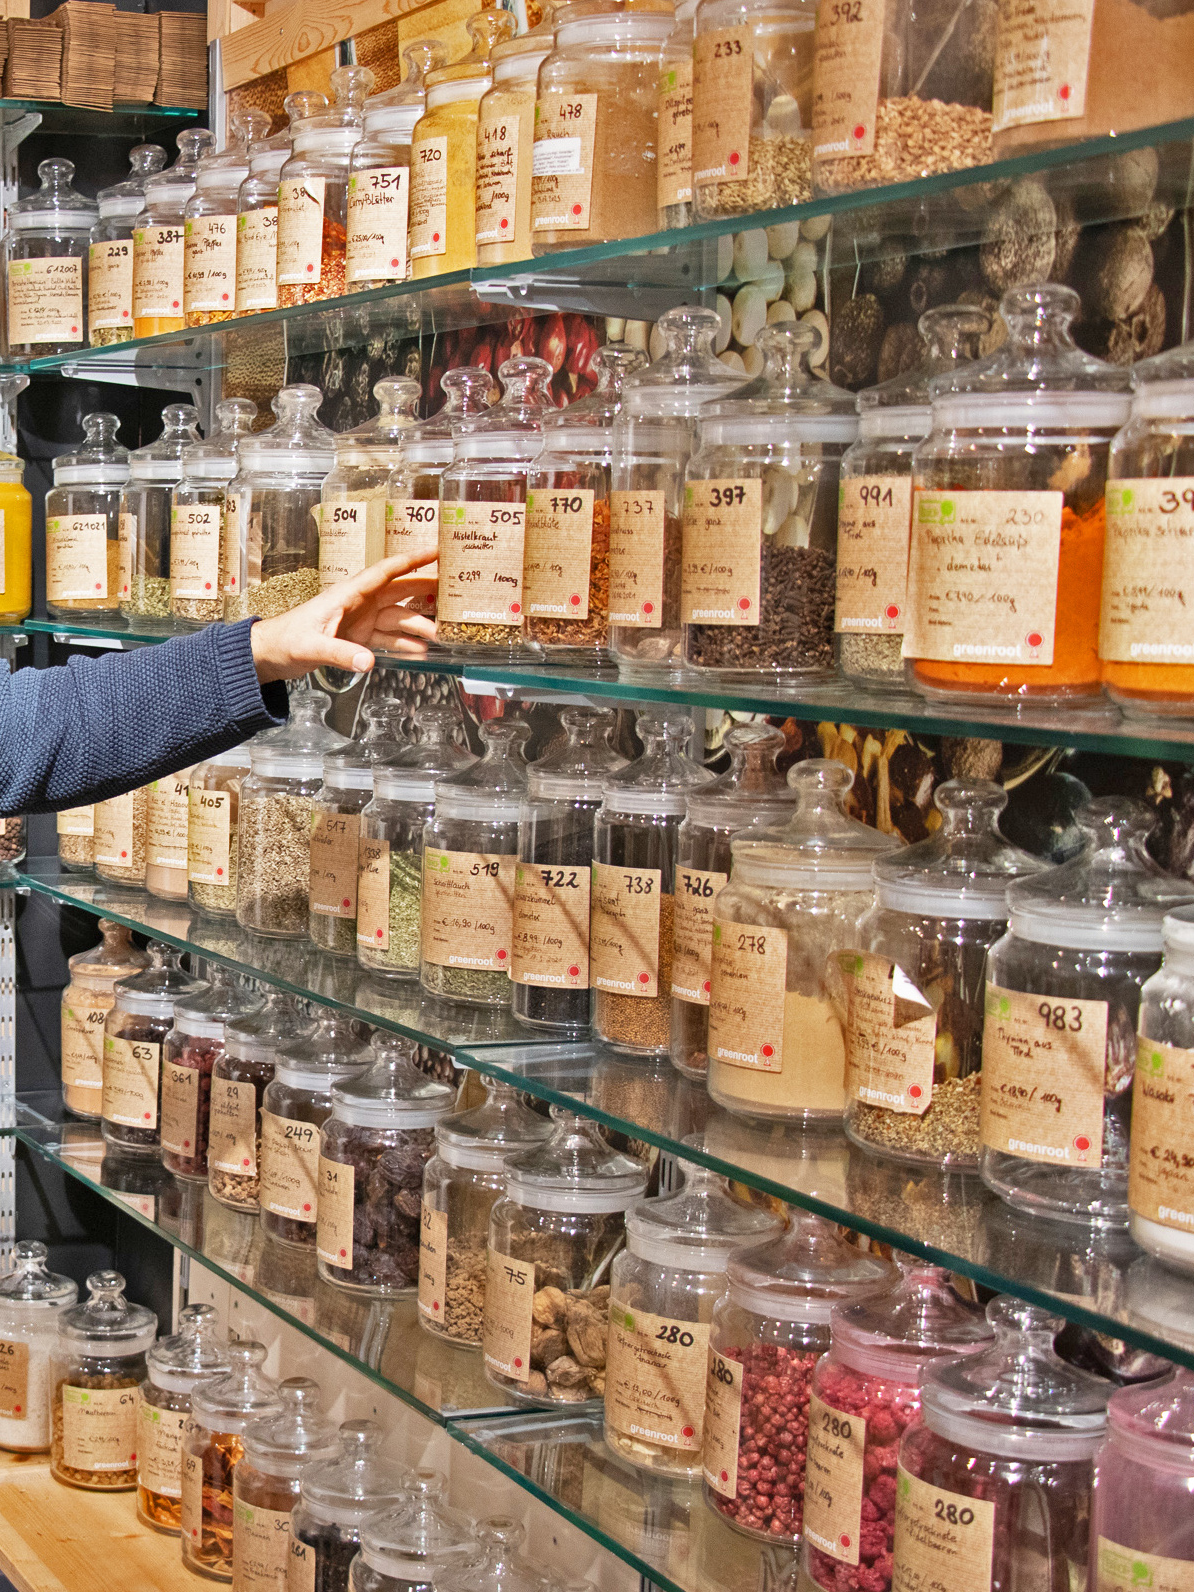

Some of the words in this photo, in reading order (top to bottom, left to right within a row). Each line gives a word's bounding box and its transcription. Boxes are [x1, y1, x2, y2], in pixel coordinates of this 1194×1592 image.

[831, 1, 863, 25] 392
[714, 39, 742, 58] 233
[559, 103, 582, 120] 478
[484, 125, 507, 142] 418
[420, 149, 442, 163] 720
[370, 173, 401, 190] 751
[535, 215, 569, 227] greenroot
[208, 223, 226, 235] 476
[157, 230, 184, 244] 387
[108, 246, 128, 257] 229
[46, 264, 78, 275] 612007
[35, 331, 70, 341] greenroot
[709, 485, 746, 507] 397
[859, 485, 894, 507] 991
[549, 496, 583, 514] 770
[622, 500, 654, 514] 737
[187, 512, 211, 525] 502
[333, 507, 357, 523] 504
[406, 506, 435, 522] 760
[489, 509, 524, 526] 505
[1006, 508, 1044, 525] 230
[72, 520, 106, 532] 621021
[452, 531, 499, 541] Mistelkraut
[493, 572, 519, 587] /100g
[62, 588, 93, 597] greenroot
[462, 609, 507, 621] greenroot
[530, 602, 568, 614] greenroot
[691, 608, 735, 620] greenroot
[841, 616, 883, 628] greenroot
[953, 642, 1022, 658] greenroot
[200, 797, 224, 809] 405
[470, 862, 500, 877] 519
[541, 870, 579, 889] 722
[623, 875, 654, 894] 738
[682, 875, 714, 897] 726
[313, 902, 340, 913] greenroot
[737, 934, 766, 955] 278
[449, 954, 494, 966] greenroot
[523, 971, 566, 983] greenroot
[596, 976, 636, 991] greenroot
[671, 983, 701, 999] greenroot
[1038, 1001, 1083, 1032] 983
[132, 1046, 153, 1060] 63
[717, 1047, 759, 1064] greenroot
[171, 1071, 192, 1084] 361
[226, 1086, 239, 1099] 29
[859, 1086, 906, 1105] greenroot
[112, 1113, 142, 1124] greenroot
[284, 1125, 314, 1143] 249
[1008, 1137, 1070, 1160] greenroot
[326, 1170, 338, 1182] 31
[269, 1201, 301, 1216] greenroot
[503, 1266, 528, 1286] 75
[655, 1325, 695, 1347] 280
[0, 1343, 14, 1356] 26
[630, 1423, 679, 1443] greenroot
[822, 1412, 852, 1440] 280
[94, 1460, 129, 1469] greenroot
[935, 1499, 975, 1526] 280
